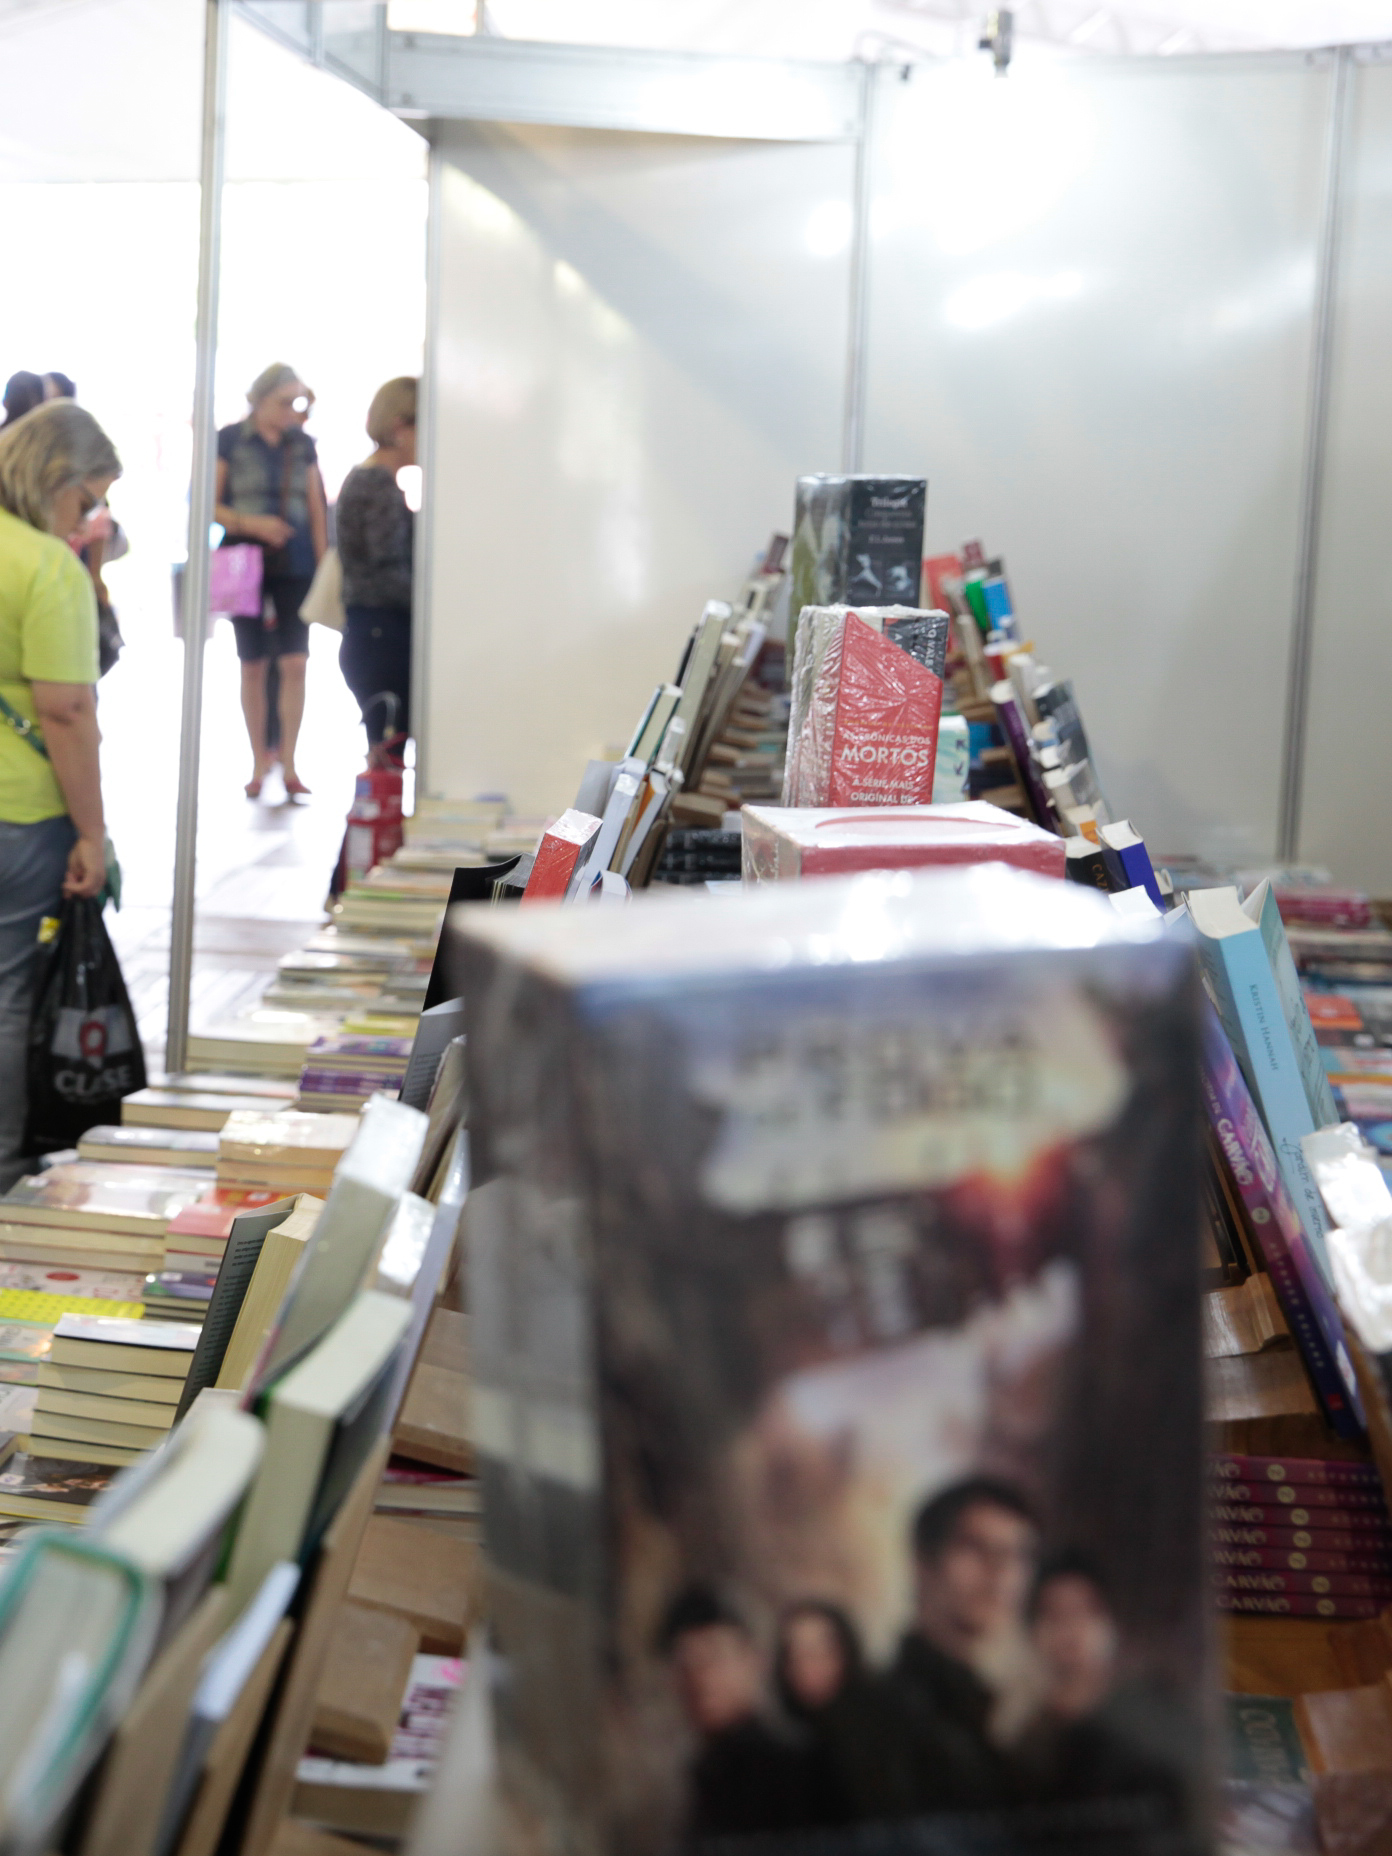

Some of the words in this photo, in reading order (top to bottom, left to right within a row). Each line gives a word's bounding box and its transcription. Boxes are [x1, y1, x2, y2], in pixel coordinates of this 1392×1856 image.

[840, 744, 929, 767] MORTOS
[850, 792, 899, 804] ORIGINAL
[1249, 983, 1266, 1024] KRISTIN
[1260, 1026, 1279, 1071] HANNAH
[1216, 1116, 1255, 1186] CARVÃO
